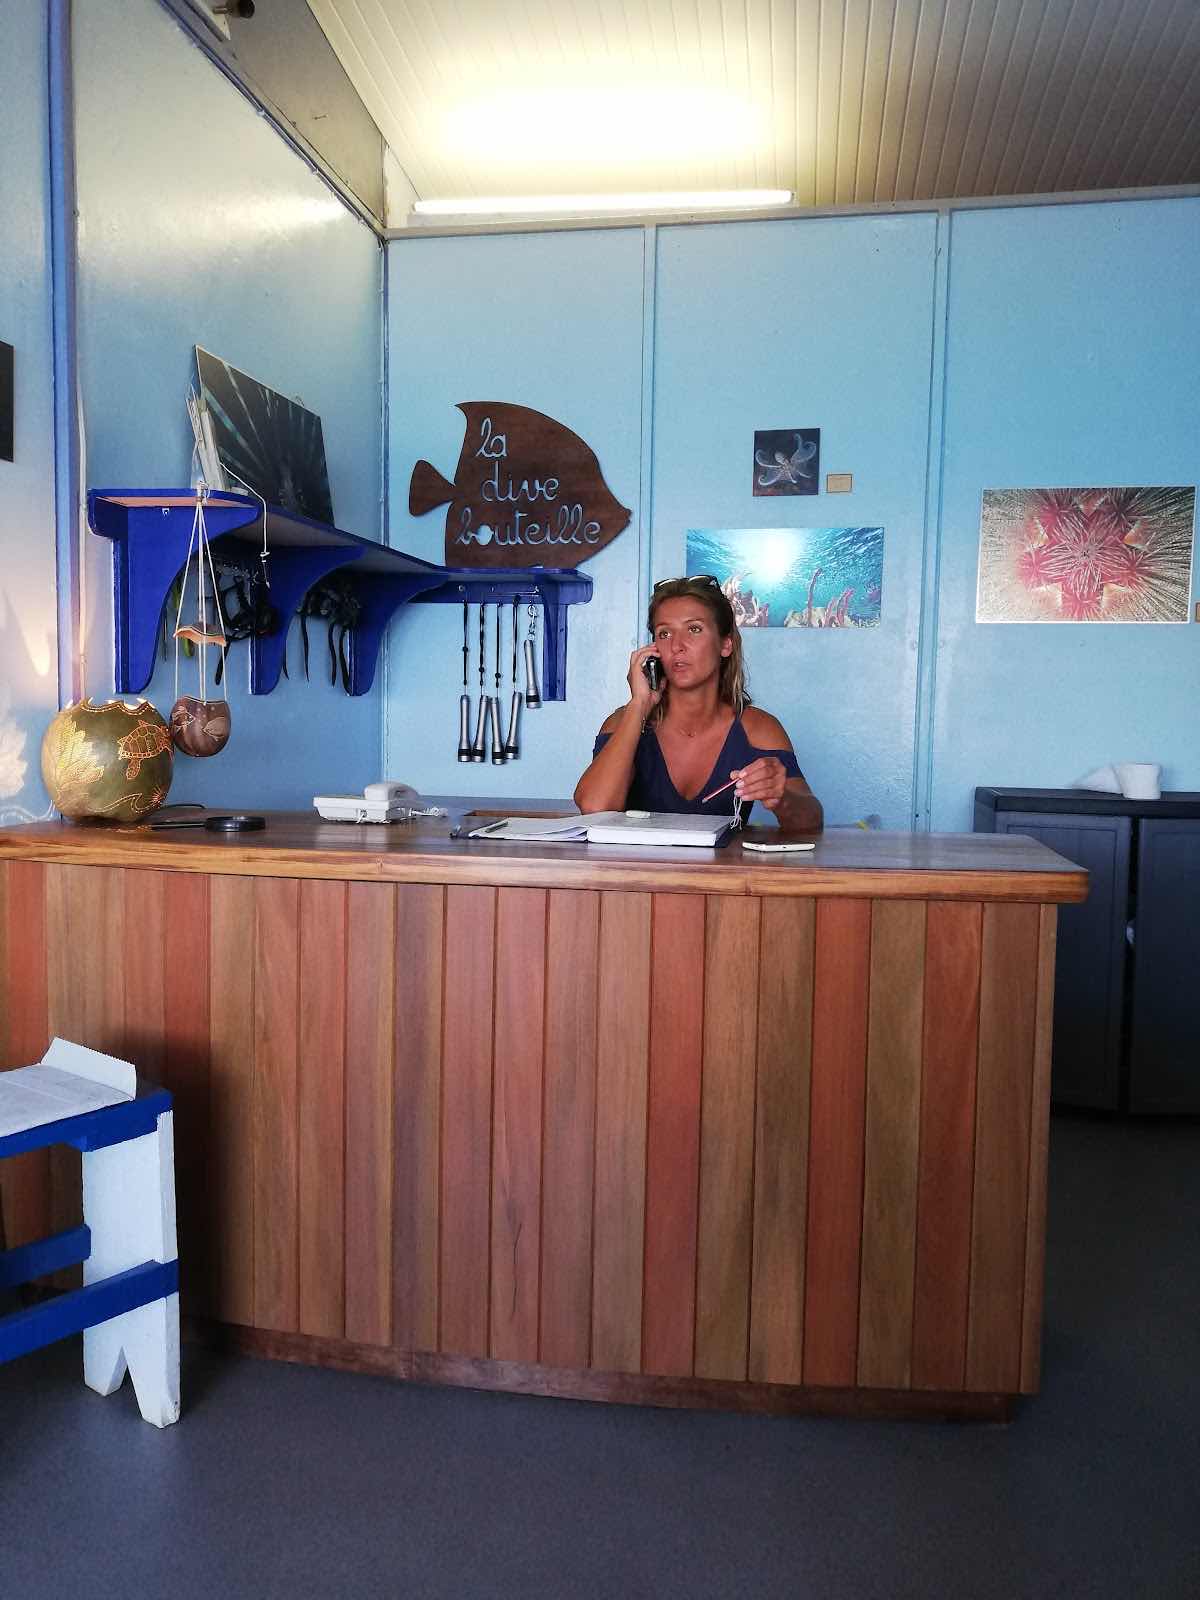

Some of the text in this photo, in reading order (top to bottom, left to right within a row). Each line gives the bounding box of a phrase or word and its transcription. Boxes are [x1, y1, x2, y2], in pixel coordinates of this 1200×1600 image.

[475, 417, 508, 458] la
[481, 460, 560, 502] dive
[455, 503, 601, 546] bouteille
